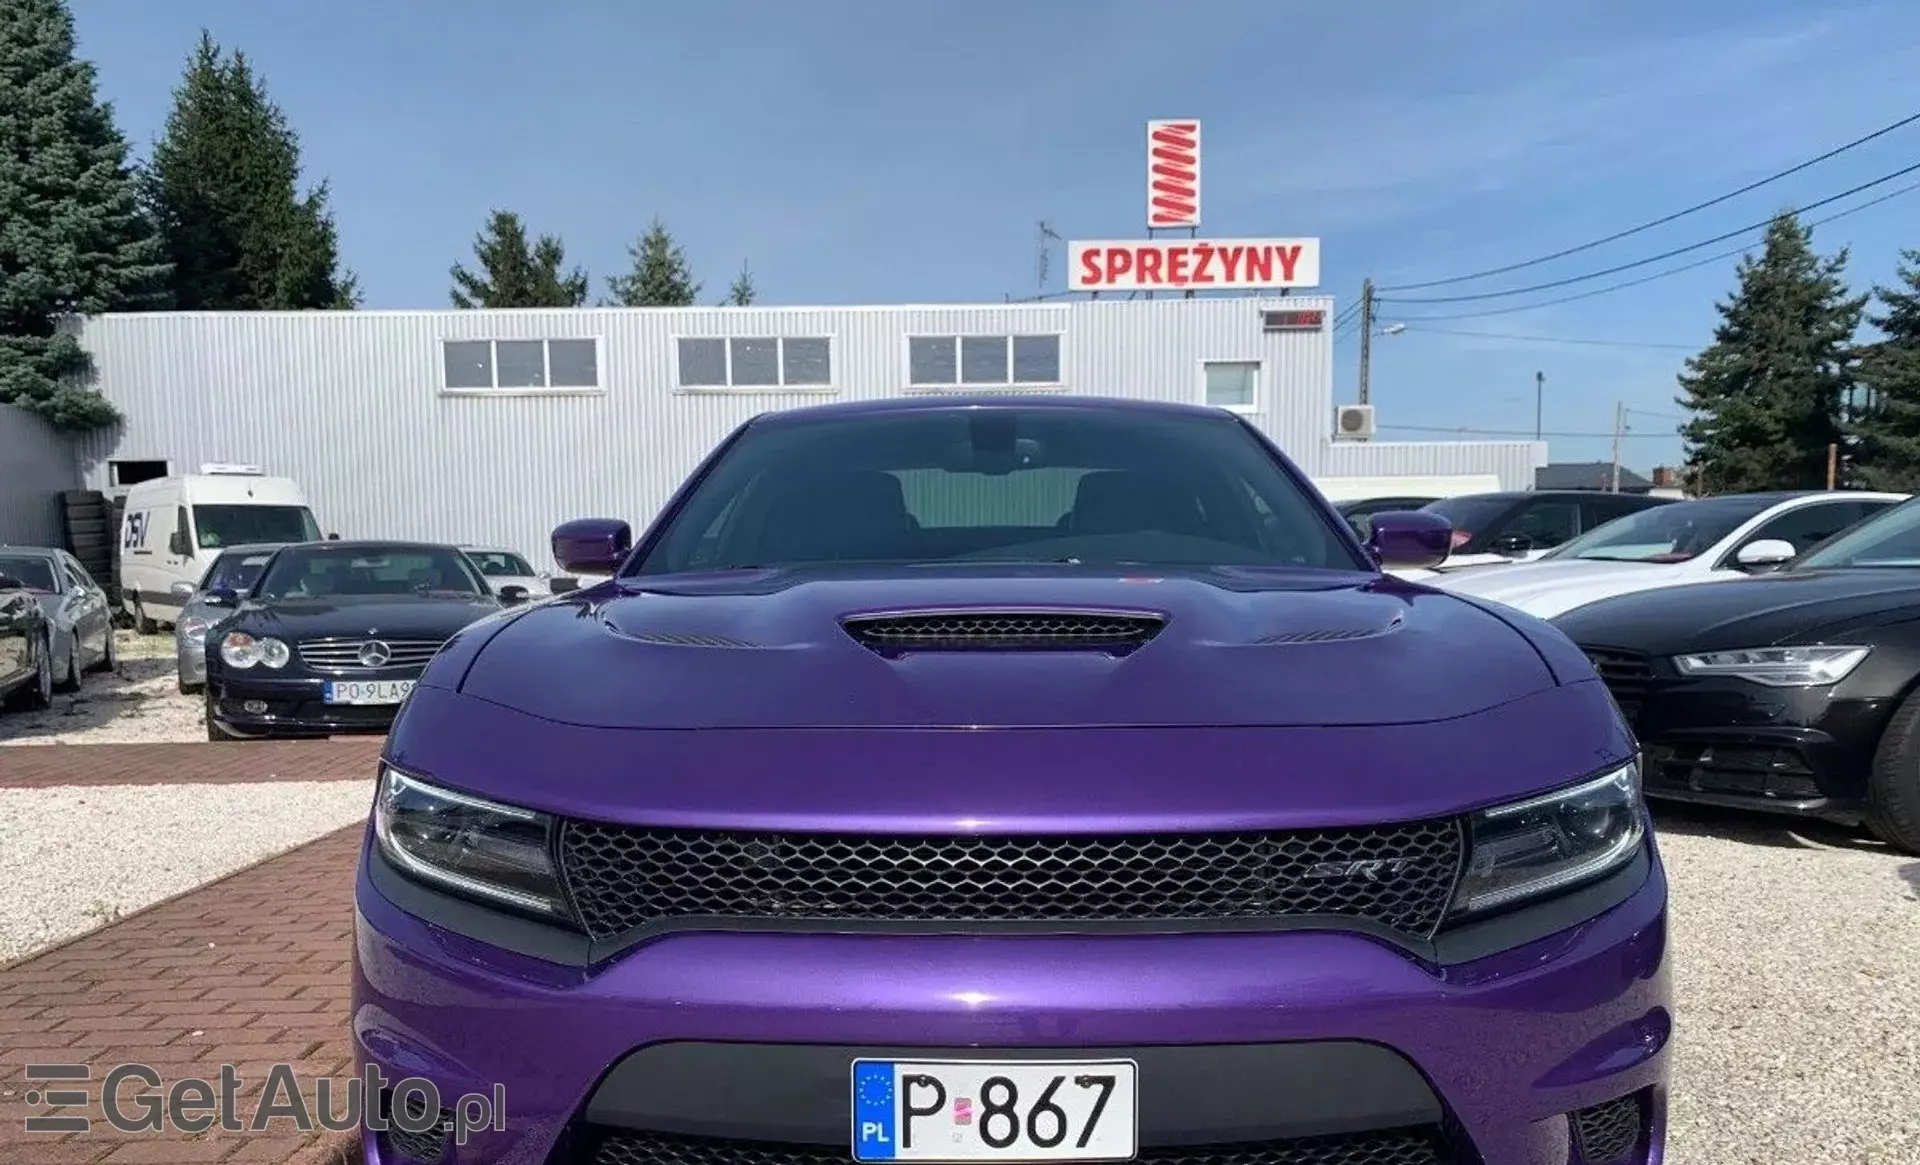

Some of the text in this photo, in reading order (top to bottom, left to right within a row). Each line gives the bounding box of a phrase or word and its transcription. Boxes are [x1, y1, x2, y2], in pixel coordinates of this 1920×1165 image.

[1081, 243, 1303, 287] SPRĘŻYNY
[124, 511, 150, 549] DSV
[366, 681, 416, 699] 9LA9
[979, 1075, 1116, 1148] 867
[862, 1122, 889, 1142] PL
